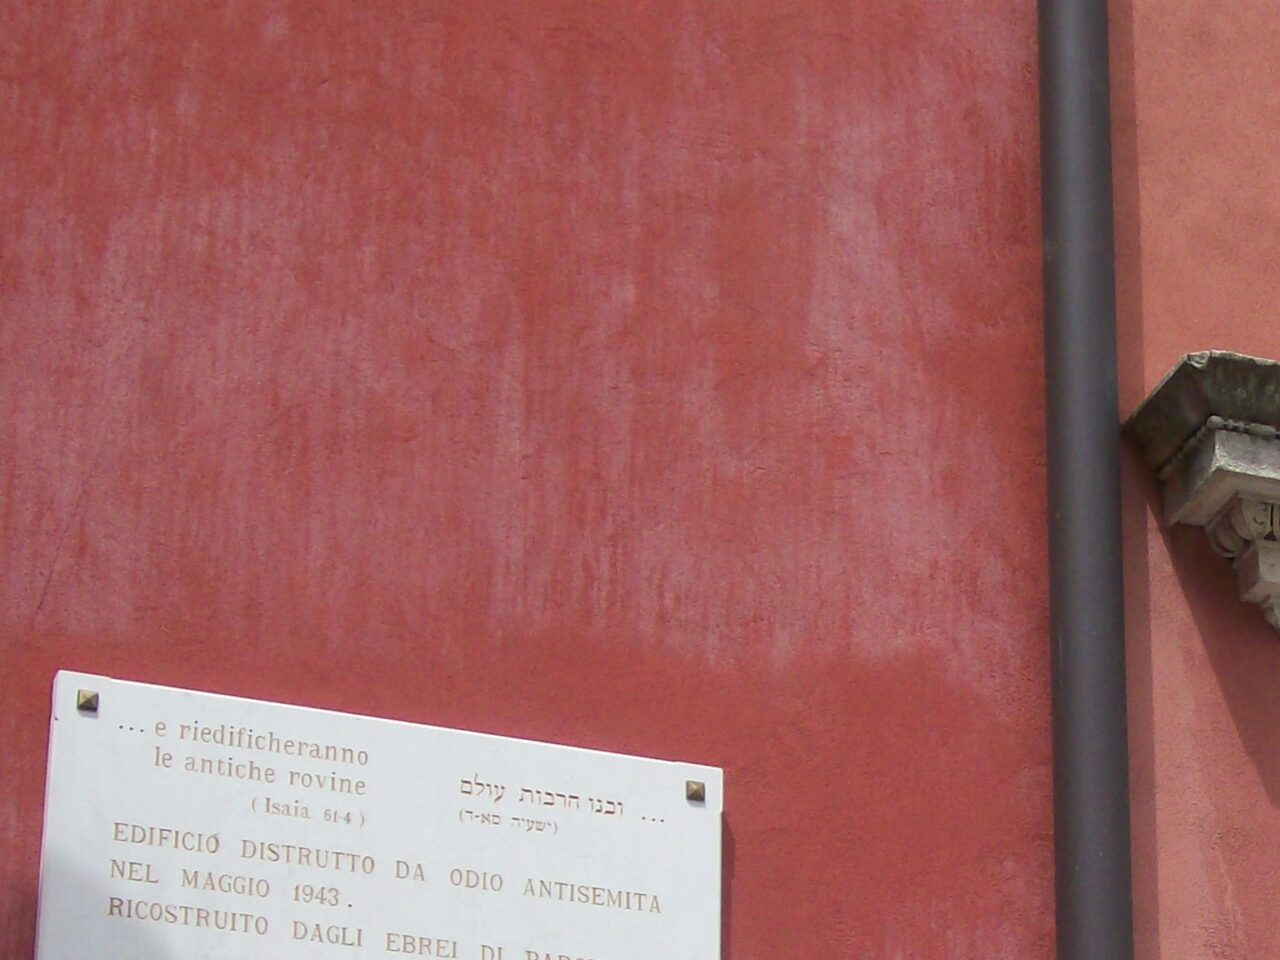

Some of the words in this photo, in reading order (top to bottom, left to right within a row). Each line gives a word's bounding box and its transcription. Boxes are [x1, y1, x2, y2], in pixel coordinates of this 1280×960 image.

[179, 720, 369, 766] riedificheranno
[153, 746, 173, 768] le
[184, 757, 276, 783] antiche
[289, 771, 366, 796] rovine
[460, 773, 505, 802] עולם
[588, 797, 624, 816] ובנו
[109, 859, 159, 884] NEL
[181, 868, 270, 898] MAGGIO
[240, 839, 376, 875] DISTRUTTO
[395, 860, 426, 882] DA
[450, 868, 504, 892] ODIO
[523, 878, 662, 914] ANTISEMITA
[107, 896, 269, 936] RICOSTRUITO
[292, 920, 363, 948] DAGLI
[385, 932, 458, 959] EBREI
